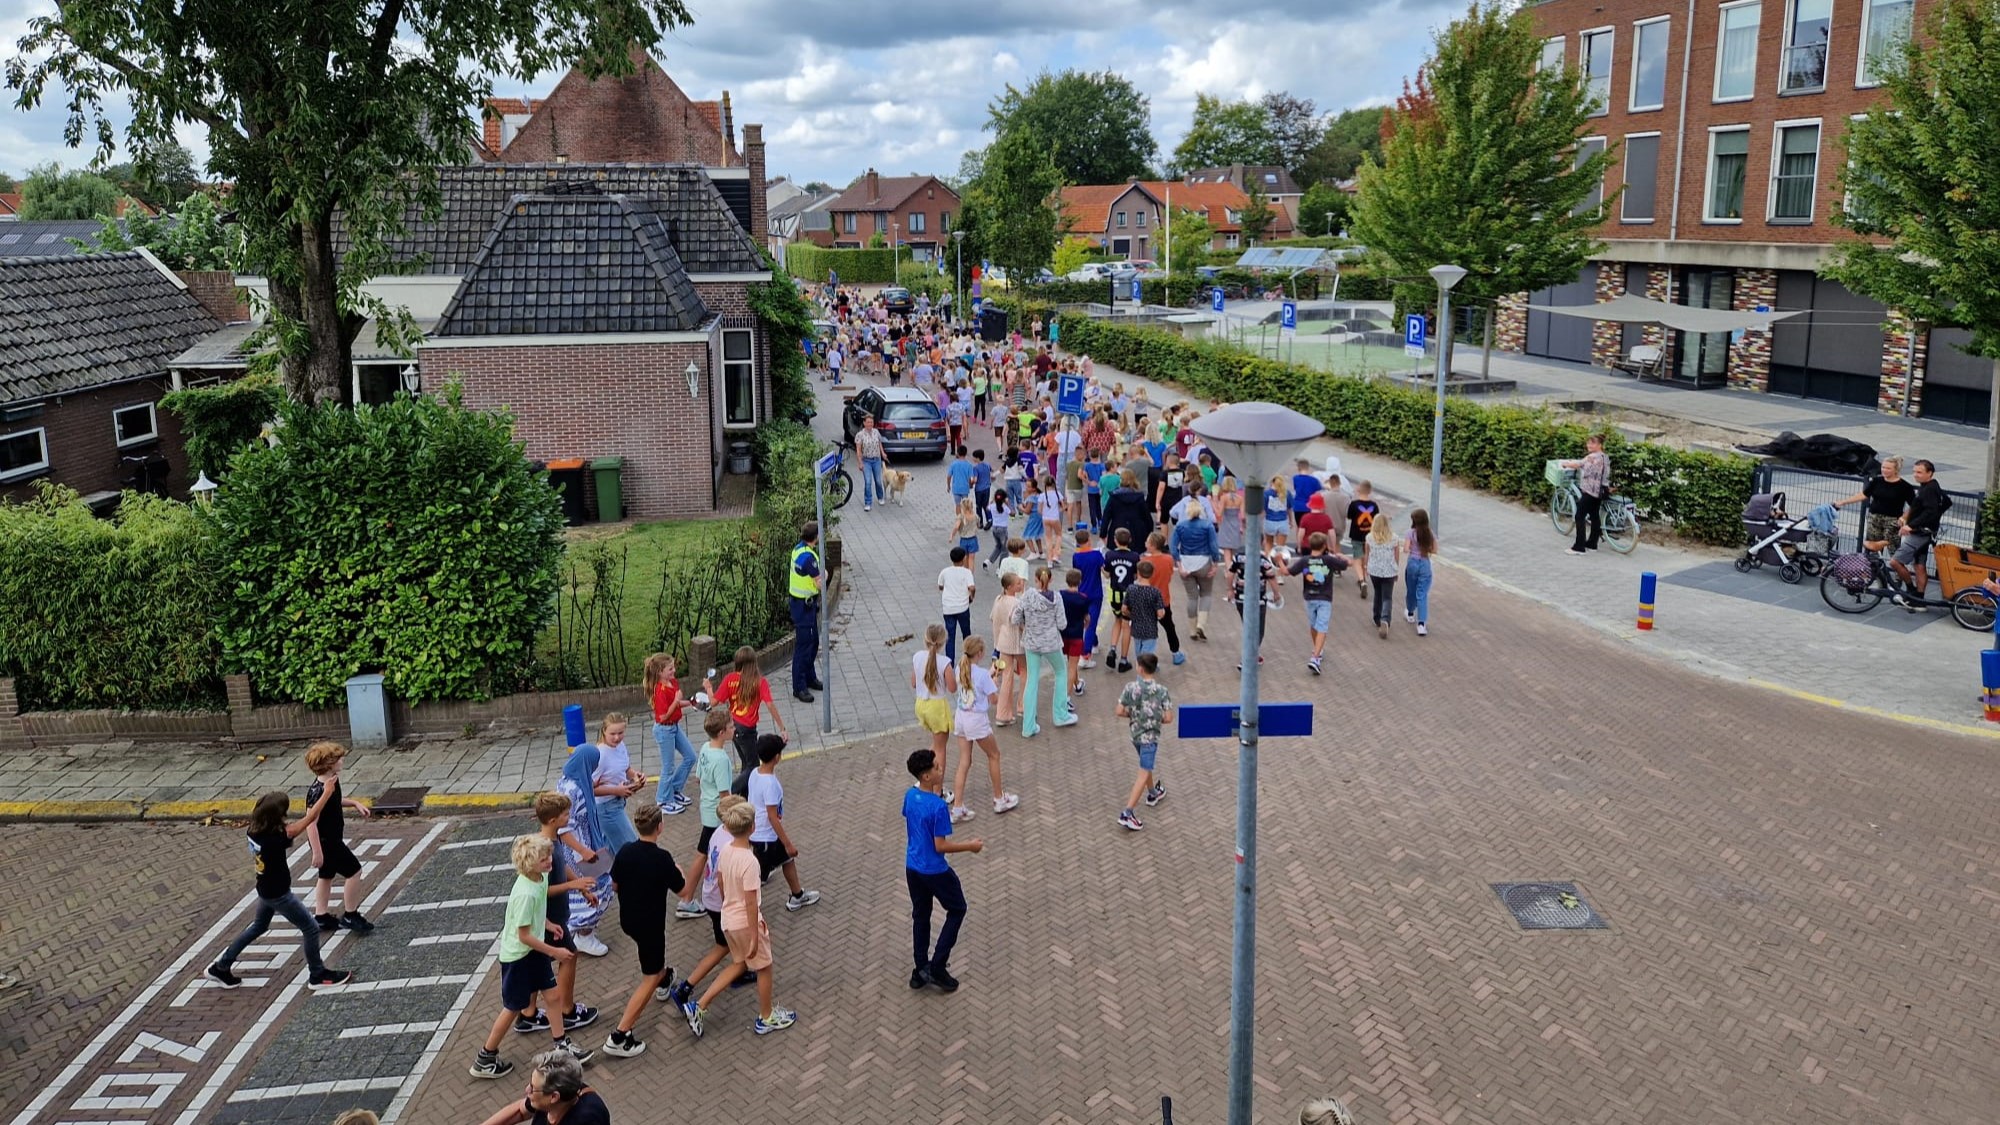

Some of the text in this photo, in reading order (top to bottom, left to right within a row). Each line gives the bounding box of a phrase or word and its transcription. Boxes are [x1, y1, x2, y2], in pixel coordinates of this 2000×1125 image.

[1214, 291, 1222, 308] P
[1284, 305, 1293, 324] P
[1409, 318, 1420, 342] P
[1063, 378, 1079, 398] P
[1114, 565, 1128, 584] 9
